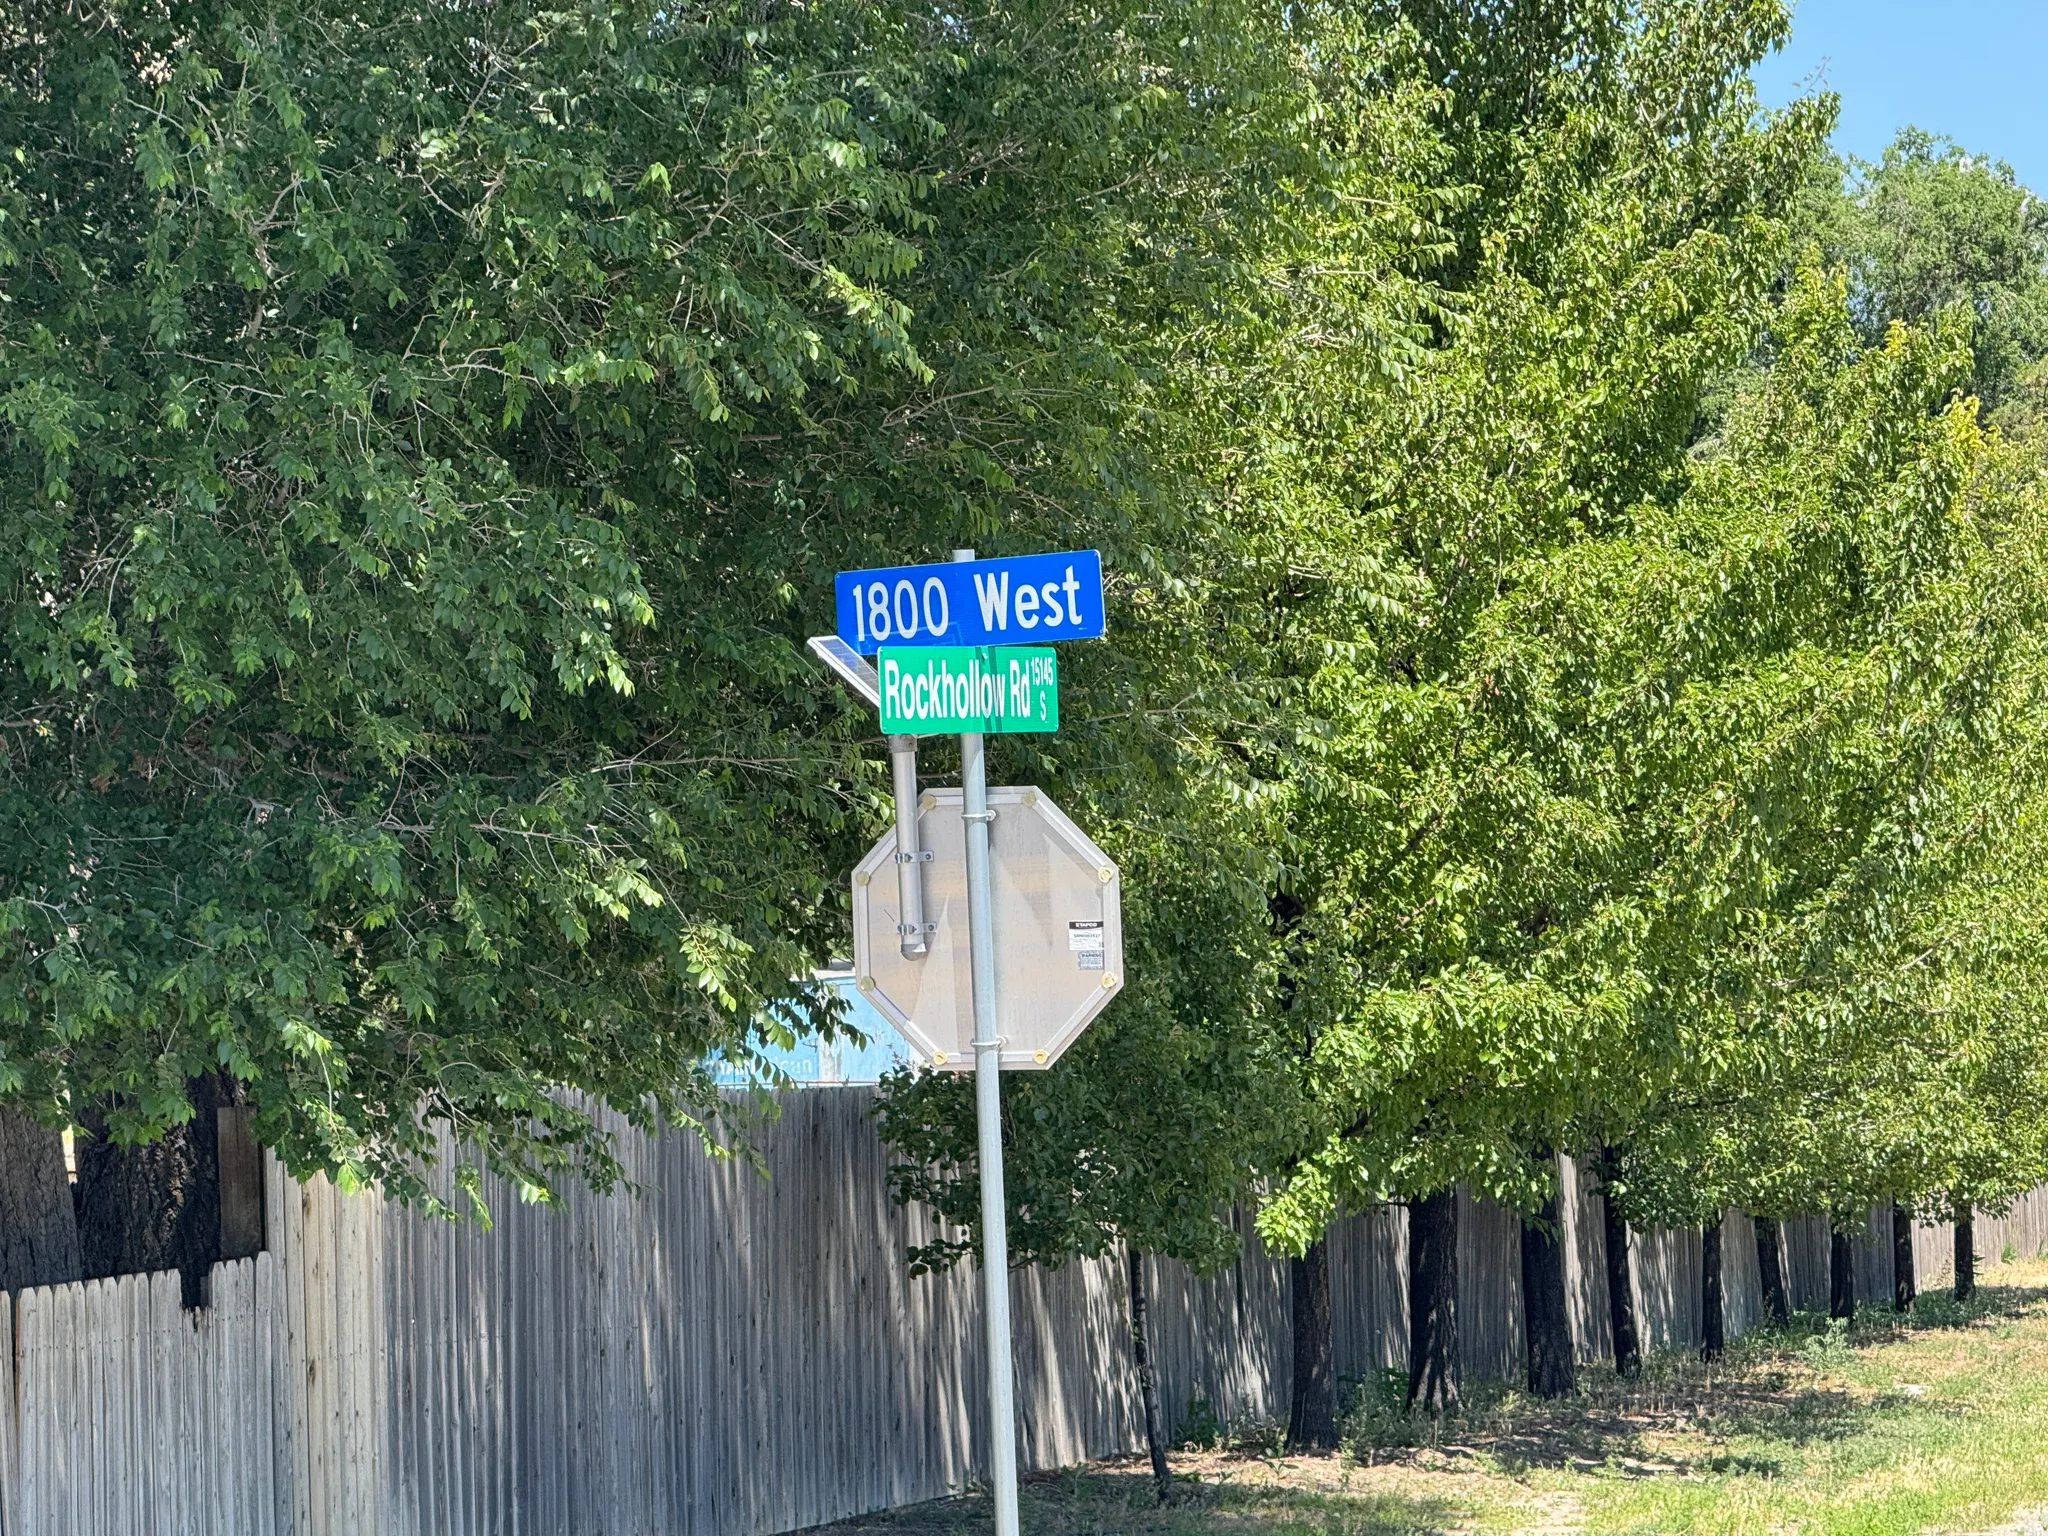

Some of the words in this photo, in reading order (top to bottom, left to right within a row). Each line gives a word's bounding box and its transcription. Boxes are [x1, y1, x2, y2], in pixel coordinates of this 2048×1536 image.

[852, 576, 949, 642] 1800
[973, 564, 1083, 632] West
[883, 659, 1006, 721] Rockhollow
[1009, 659, 1031, 719] Rd
[1031, 656, 1054, 687] 15145
[1039, 690, 1047, 721] S
